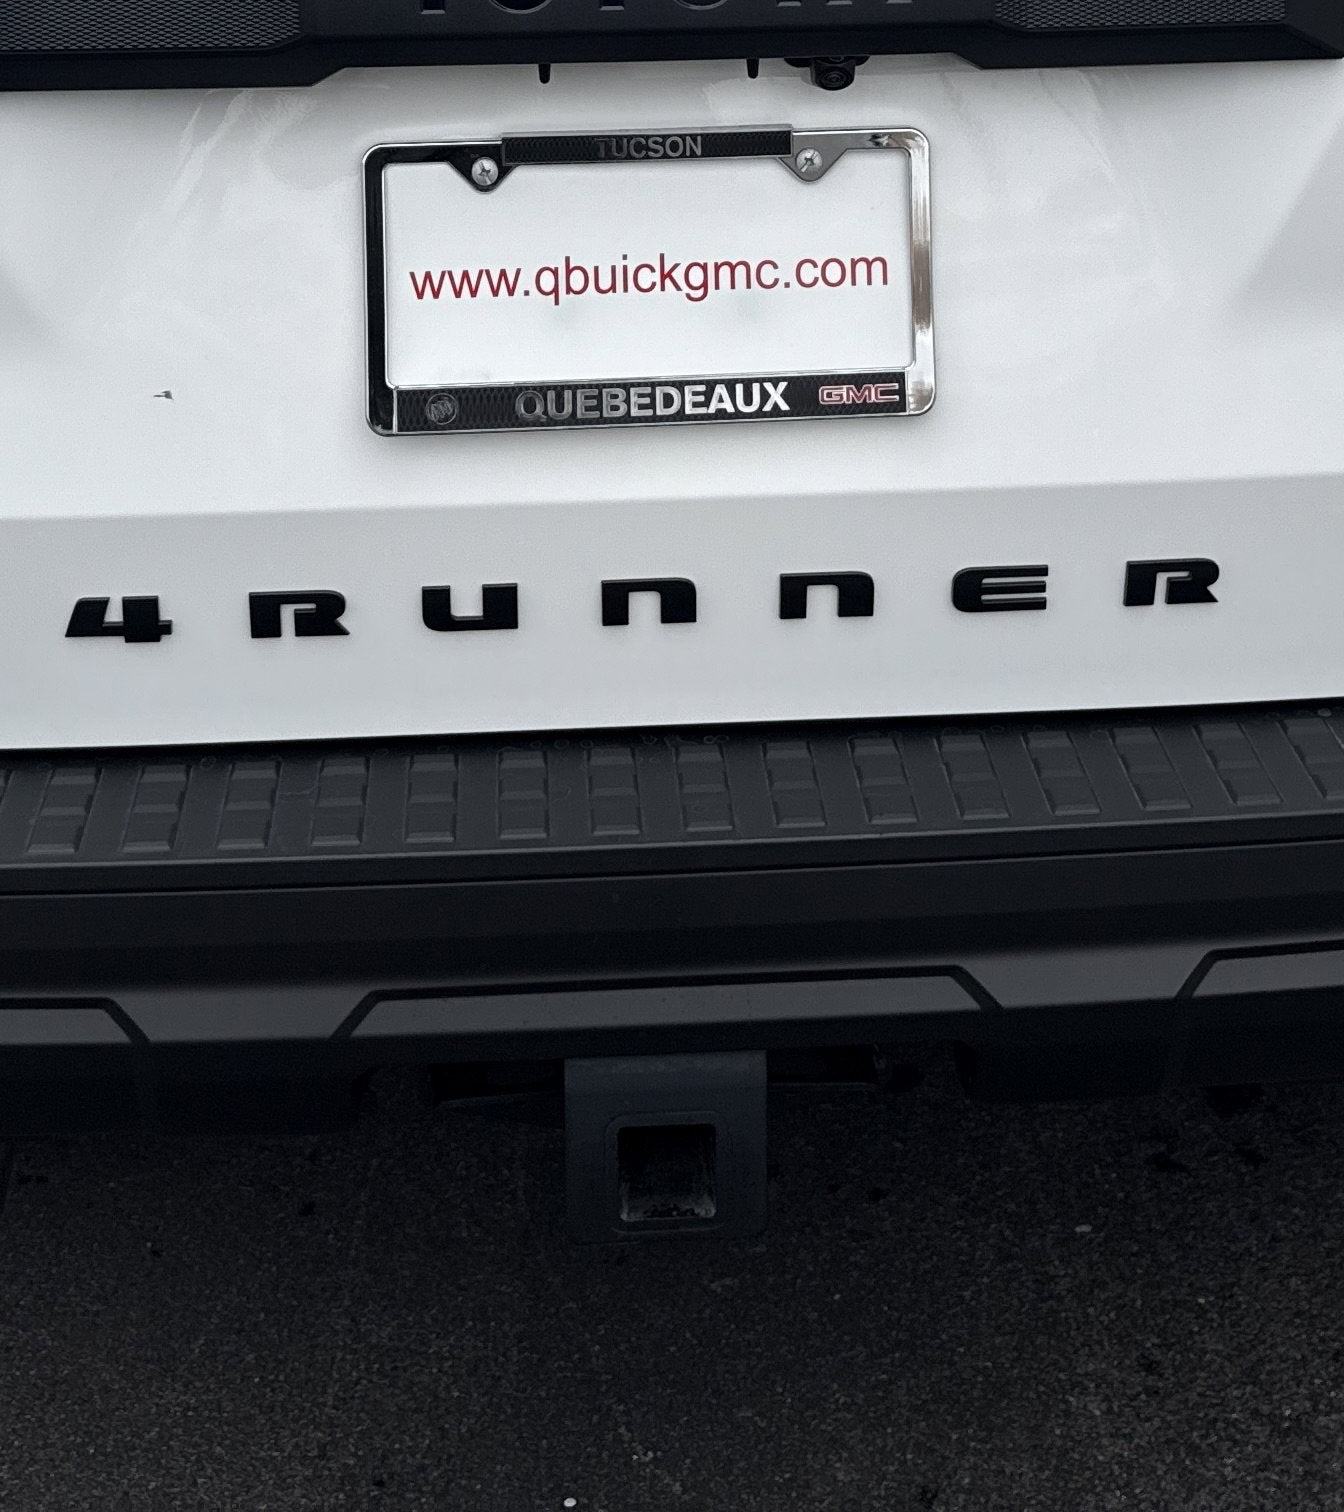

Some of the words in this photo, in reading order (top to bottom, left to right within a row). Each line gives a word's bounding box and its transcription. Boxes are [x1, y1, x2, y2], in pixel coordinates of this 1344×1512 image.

[594, 134, 703, 160] TUCSON
[409, 252, 889, 306] www.qbuickgmc.com
[515, 380, 791, 422] QUEBEDEAUX
[818, 382, 901, 406] GMC
[64, 556, 1223, 644] 4RUNNER
